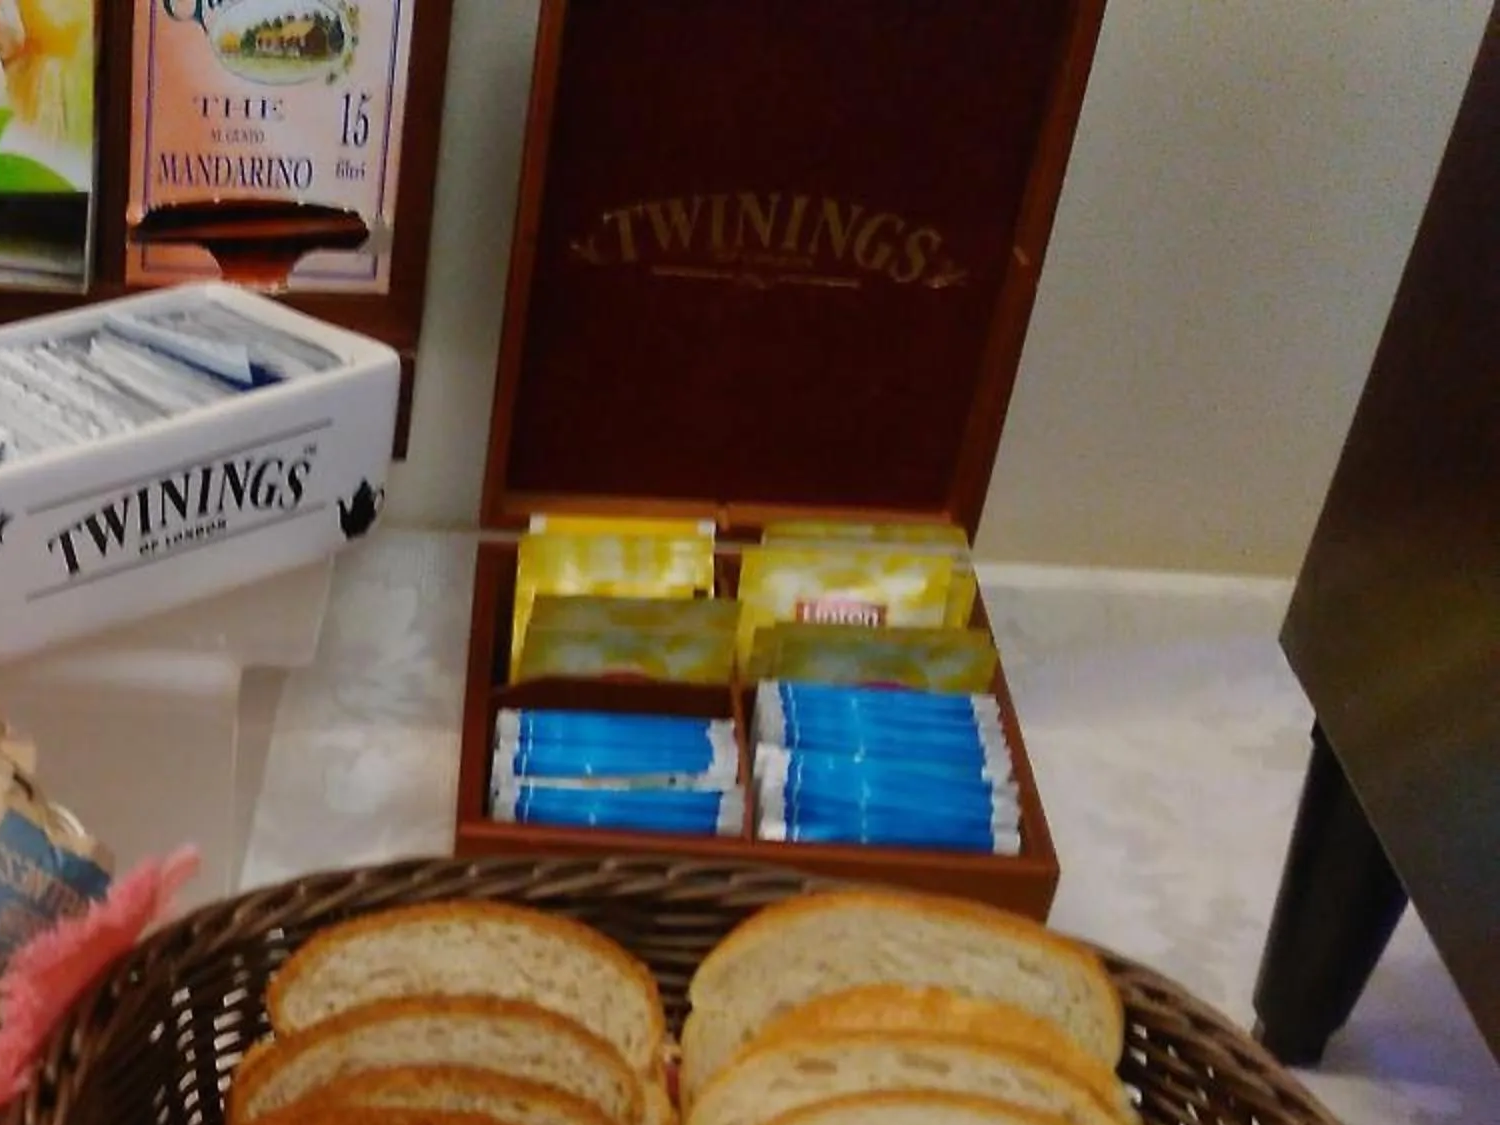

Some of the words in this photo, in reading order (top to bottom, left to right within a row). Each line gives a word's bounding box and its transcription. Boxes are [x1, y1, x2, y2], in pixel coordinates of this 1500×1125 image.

[340, 92, 372, 148] 15
[158, 152, 314, 190] MANDARINO
[603, 192, 942, 284] TWININGS
[47, 455, 313, 577] TWININGS
